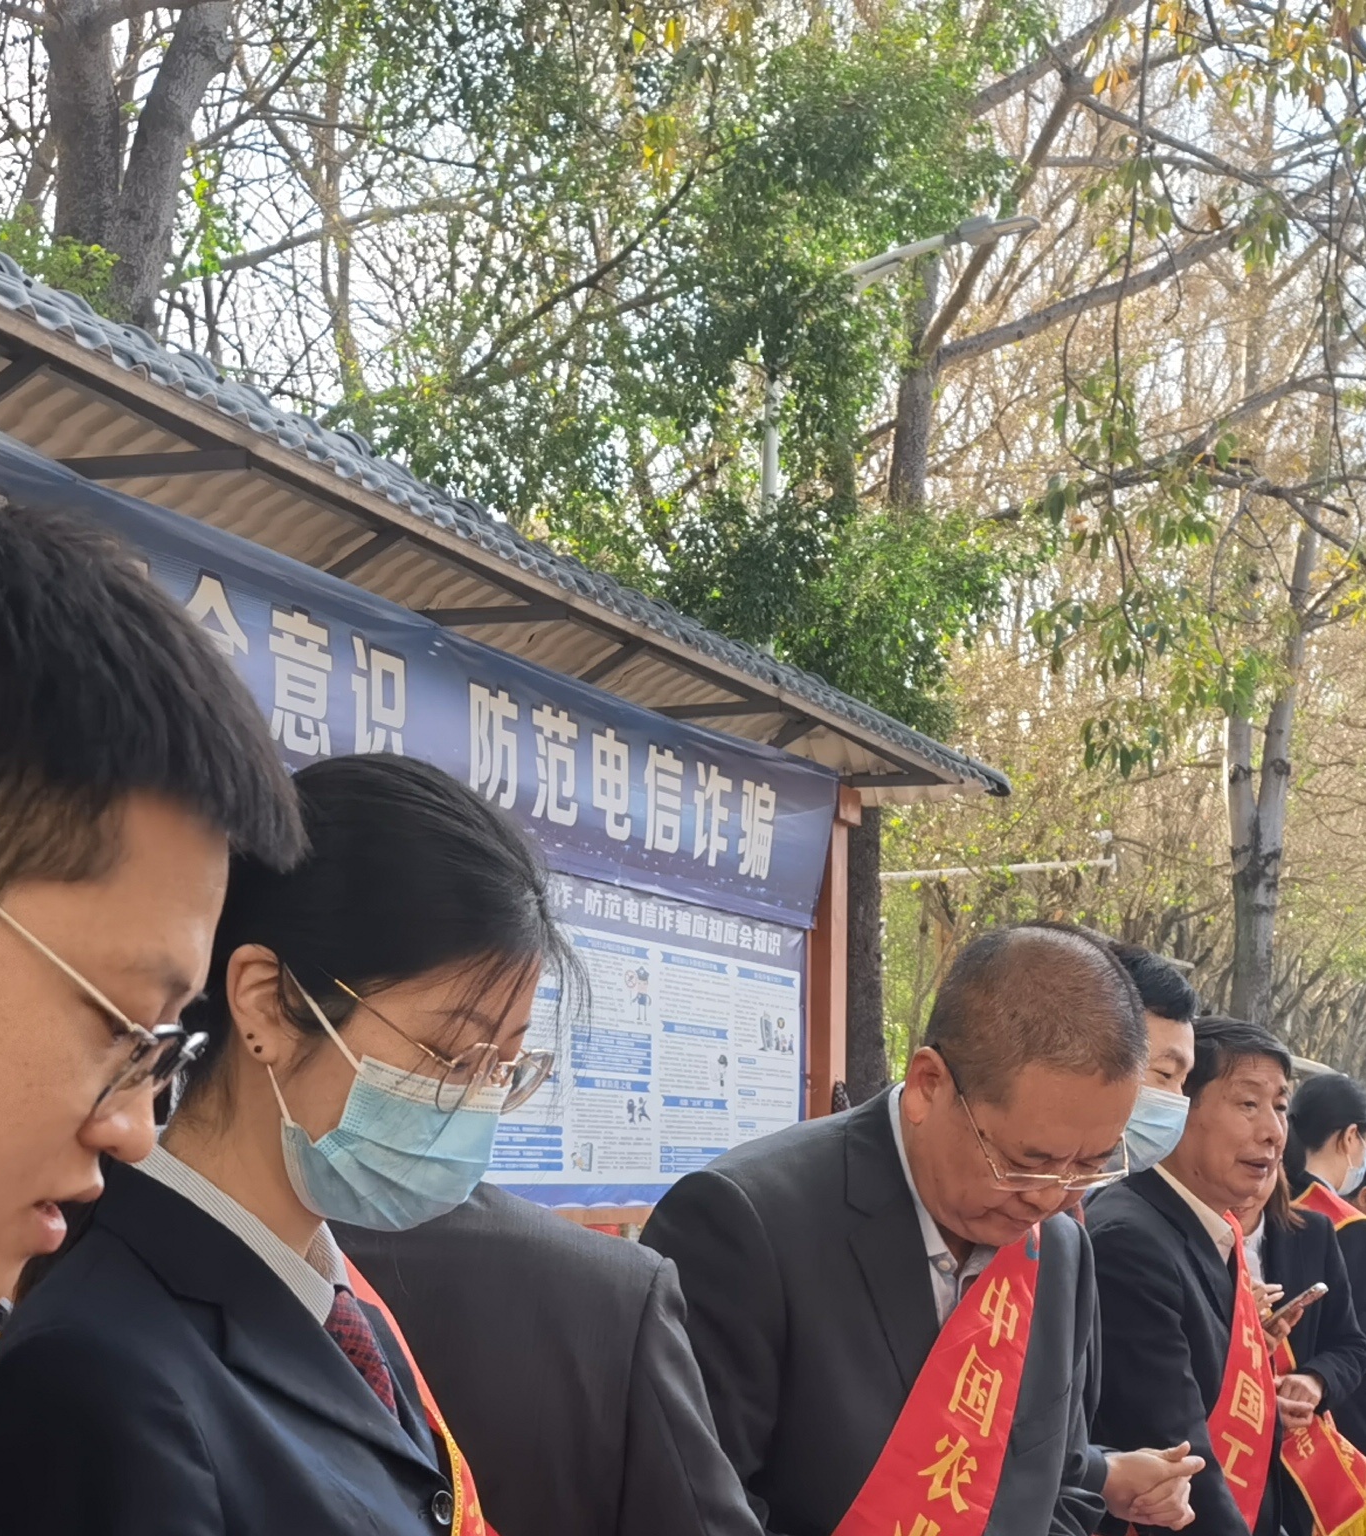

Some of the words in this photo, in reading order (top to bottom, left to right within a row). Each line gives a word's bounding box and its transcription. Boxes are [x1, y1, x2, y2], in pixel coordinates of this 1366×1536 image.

[468, 681, 777, 880] 防范电信诈骗
